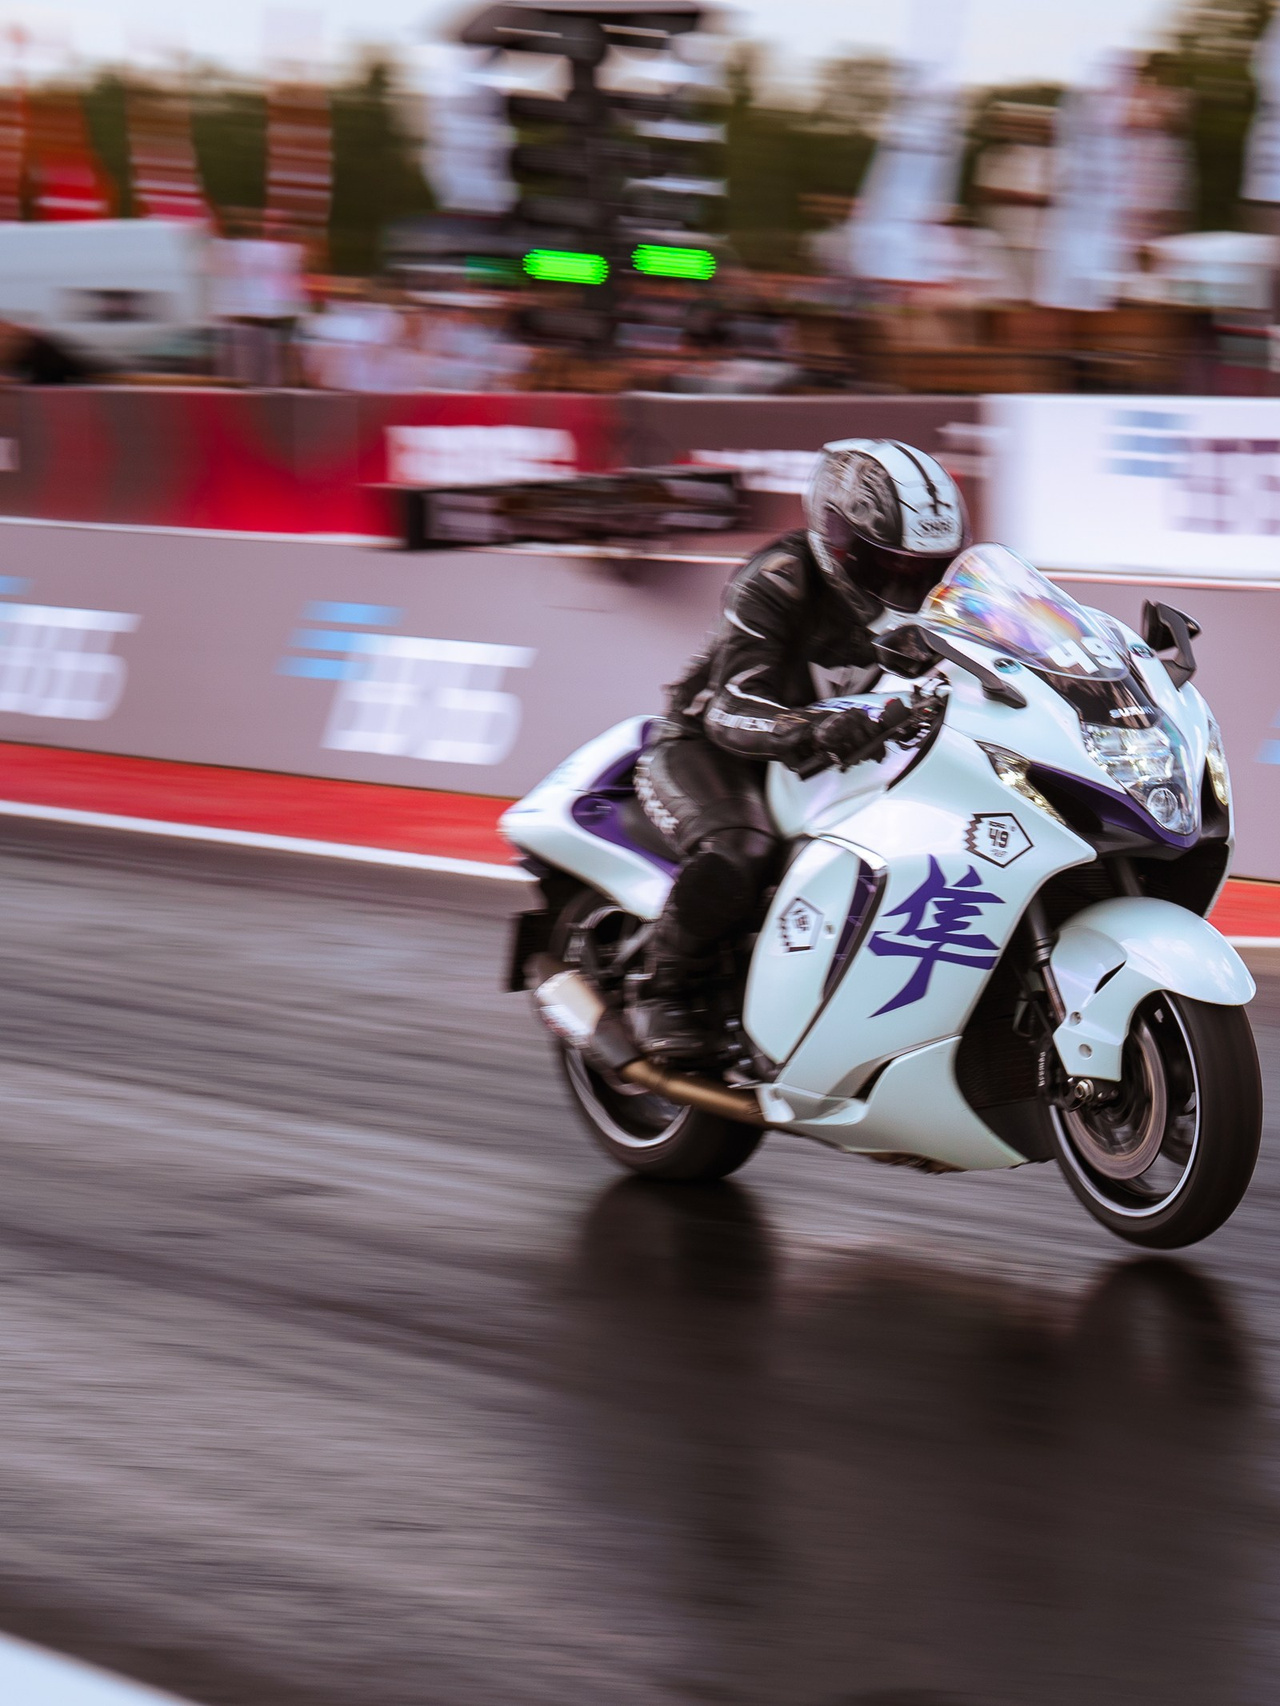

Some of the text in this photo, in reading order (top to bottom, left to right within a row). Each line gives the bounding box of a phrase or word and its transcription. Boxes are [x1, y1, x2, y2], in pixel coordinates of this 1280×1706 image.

[1044, 636, 1125, 675] 49
[990, 828, 1009, 848] 49
[867, 853, 1006, 1018] 隼
